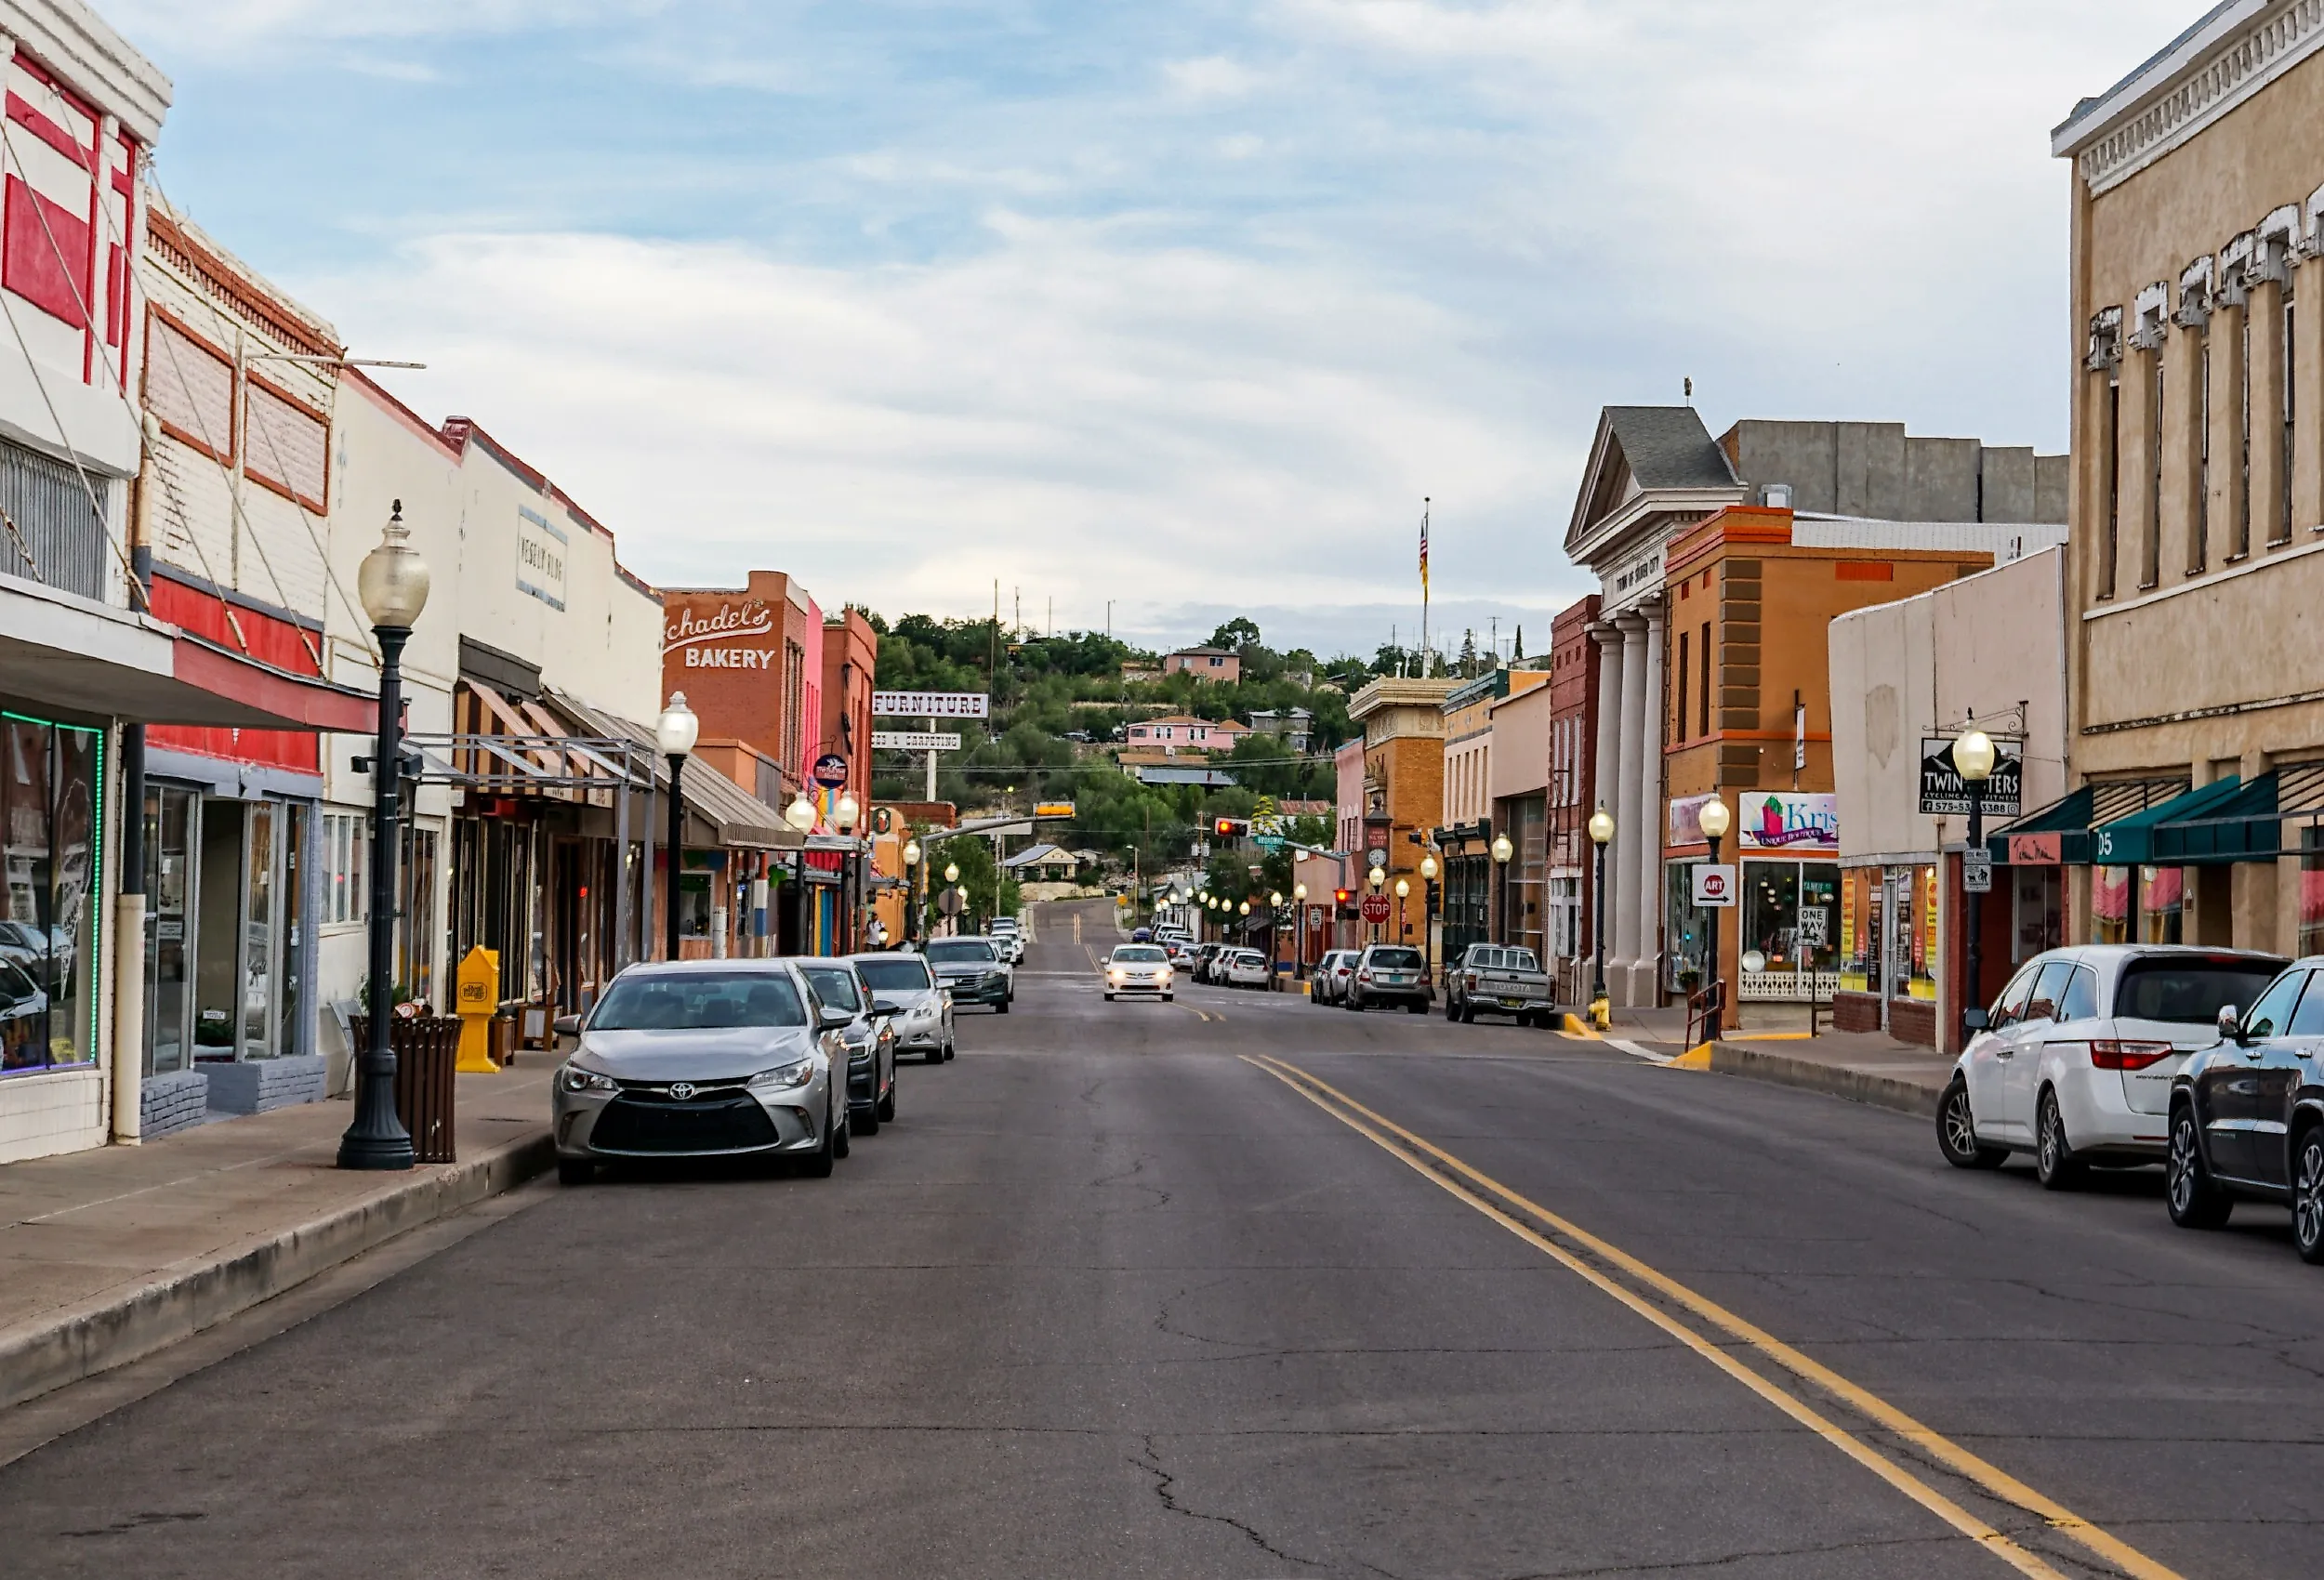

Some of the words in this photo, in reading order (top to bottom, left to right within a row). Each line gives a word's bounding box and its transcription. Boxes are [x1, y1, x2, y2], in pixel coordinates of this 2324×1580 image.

[1617, 574, 1627, 592] TOWN
[1650, 555, 1658, 573] CITY
[662, 599, 771, 640] chadel's
[685, 648, 775, 669] BAKERY
[874, 695, 981, 714] FURNITURE
[906, 735, 957, 746] CARPETING
[1924, 772, 1963, 792] TWIN
[1963, 774, 2017, 795] TERS
[1761, 836, 1787, 846] UNIQUE
[1705, 879, 1723, 891] ART
[1364, 902, 1390, 915] STOP
[1802, 911, 1823, 920] ONE
[1801, 921, 1823, 930] WAY
[1494, 981, 1532, 993] TOYOTA
